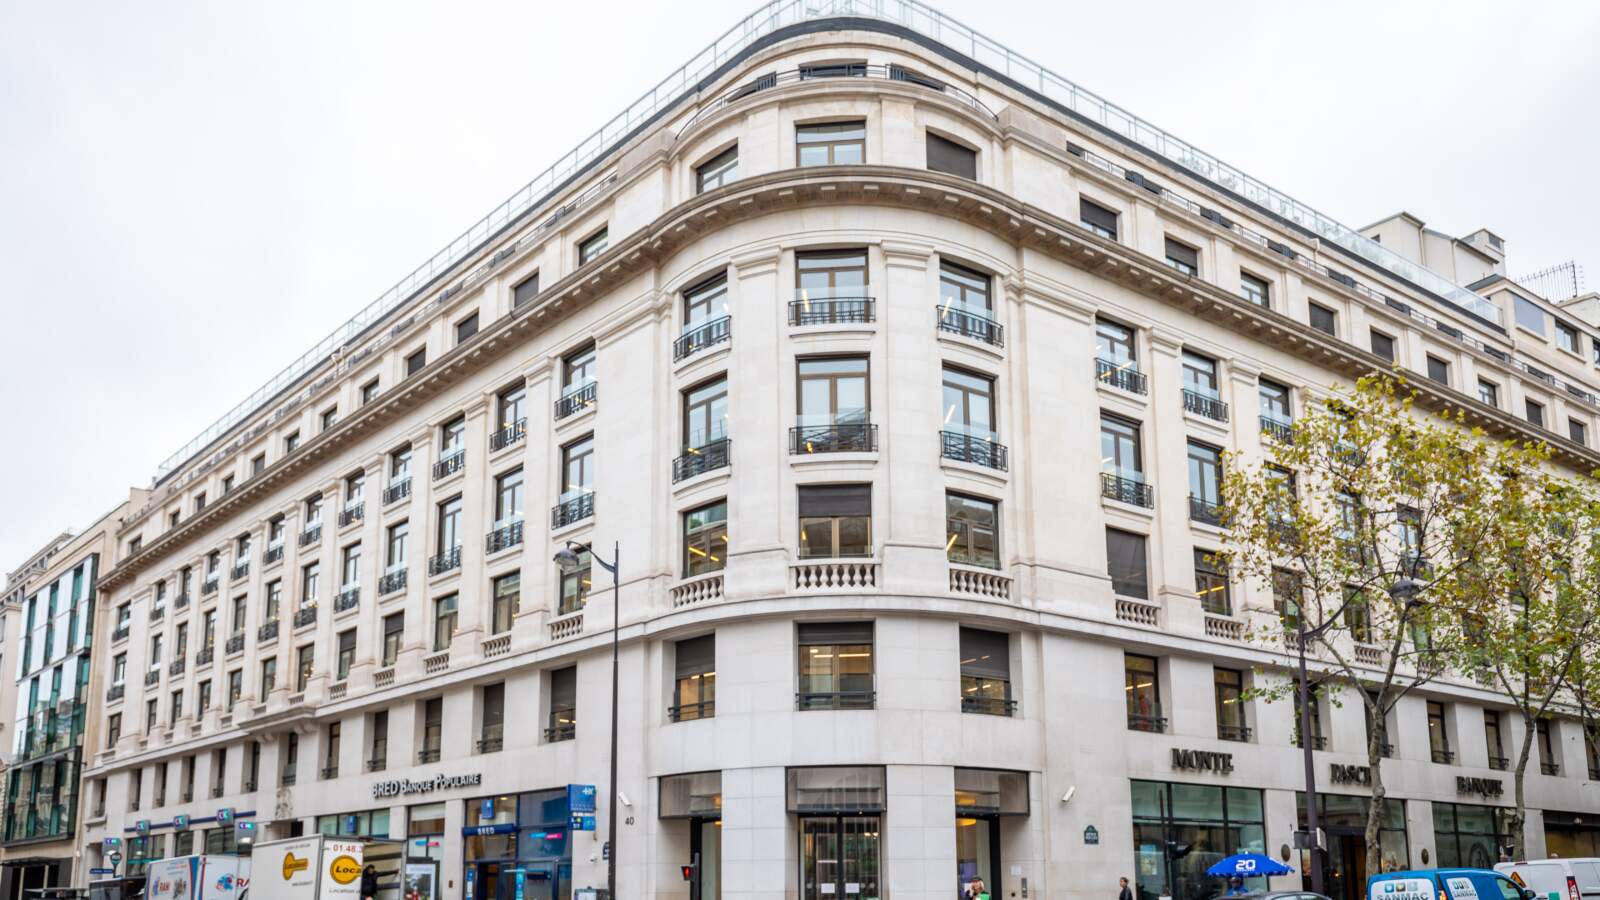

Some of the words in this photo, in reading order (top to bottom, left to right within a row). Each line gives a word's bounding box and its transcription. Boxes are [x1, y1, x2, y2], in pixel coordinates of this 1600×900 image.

[1171, 748, 1233, 773] MONTE
[1456, 776, 1504, 799] BANQUE
[371, 780, 400, 798] BRED
[625, 816, 635, 825] 40
[1235, 859, 1256, 870] 20
